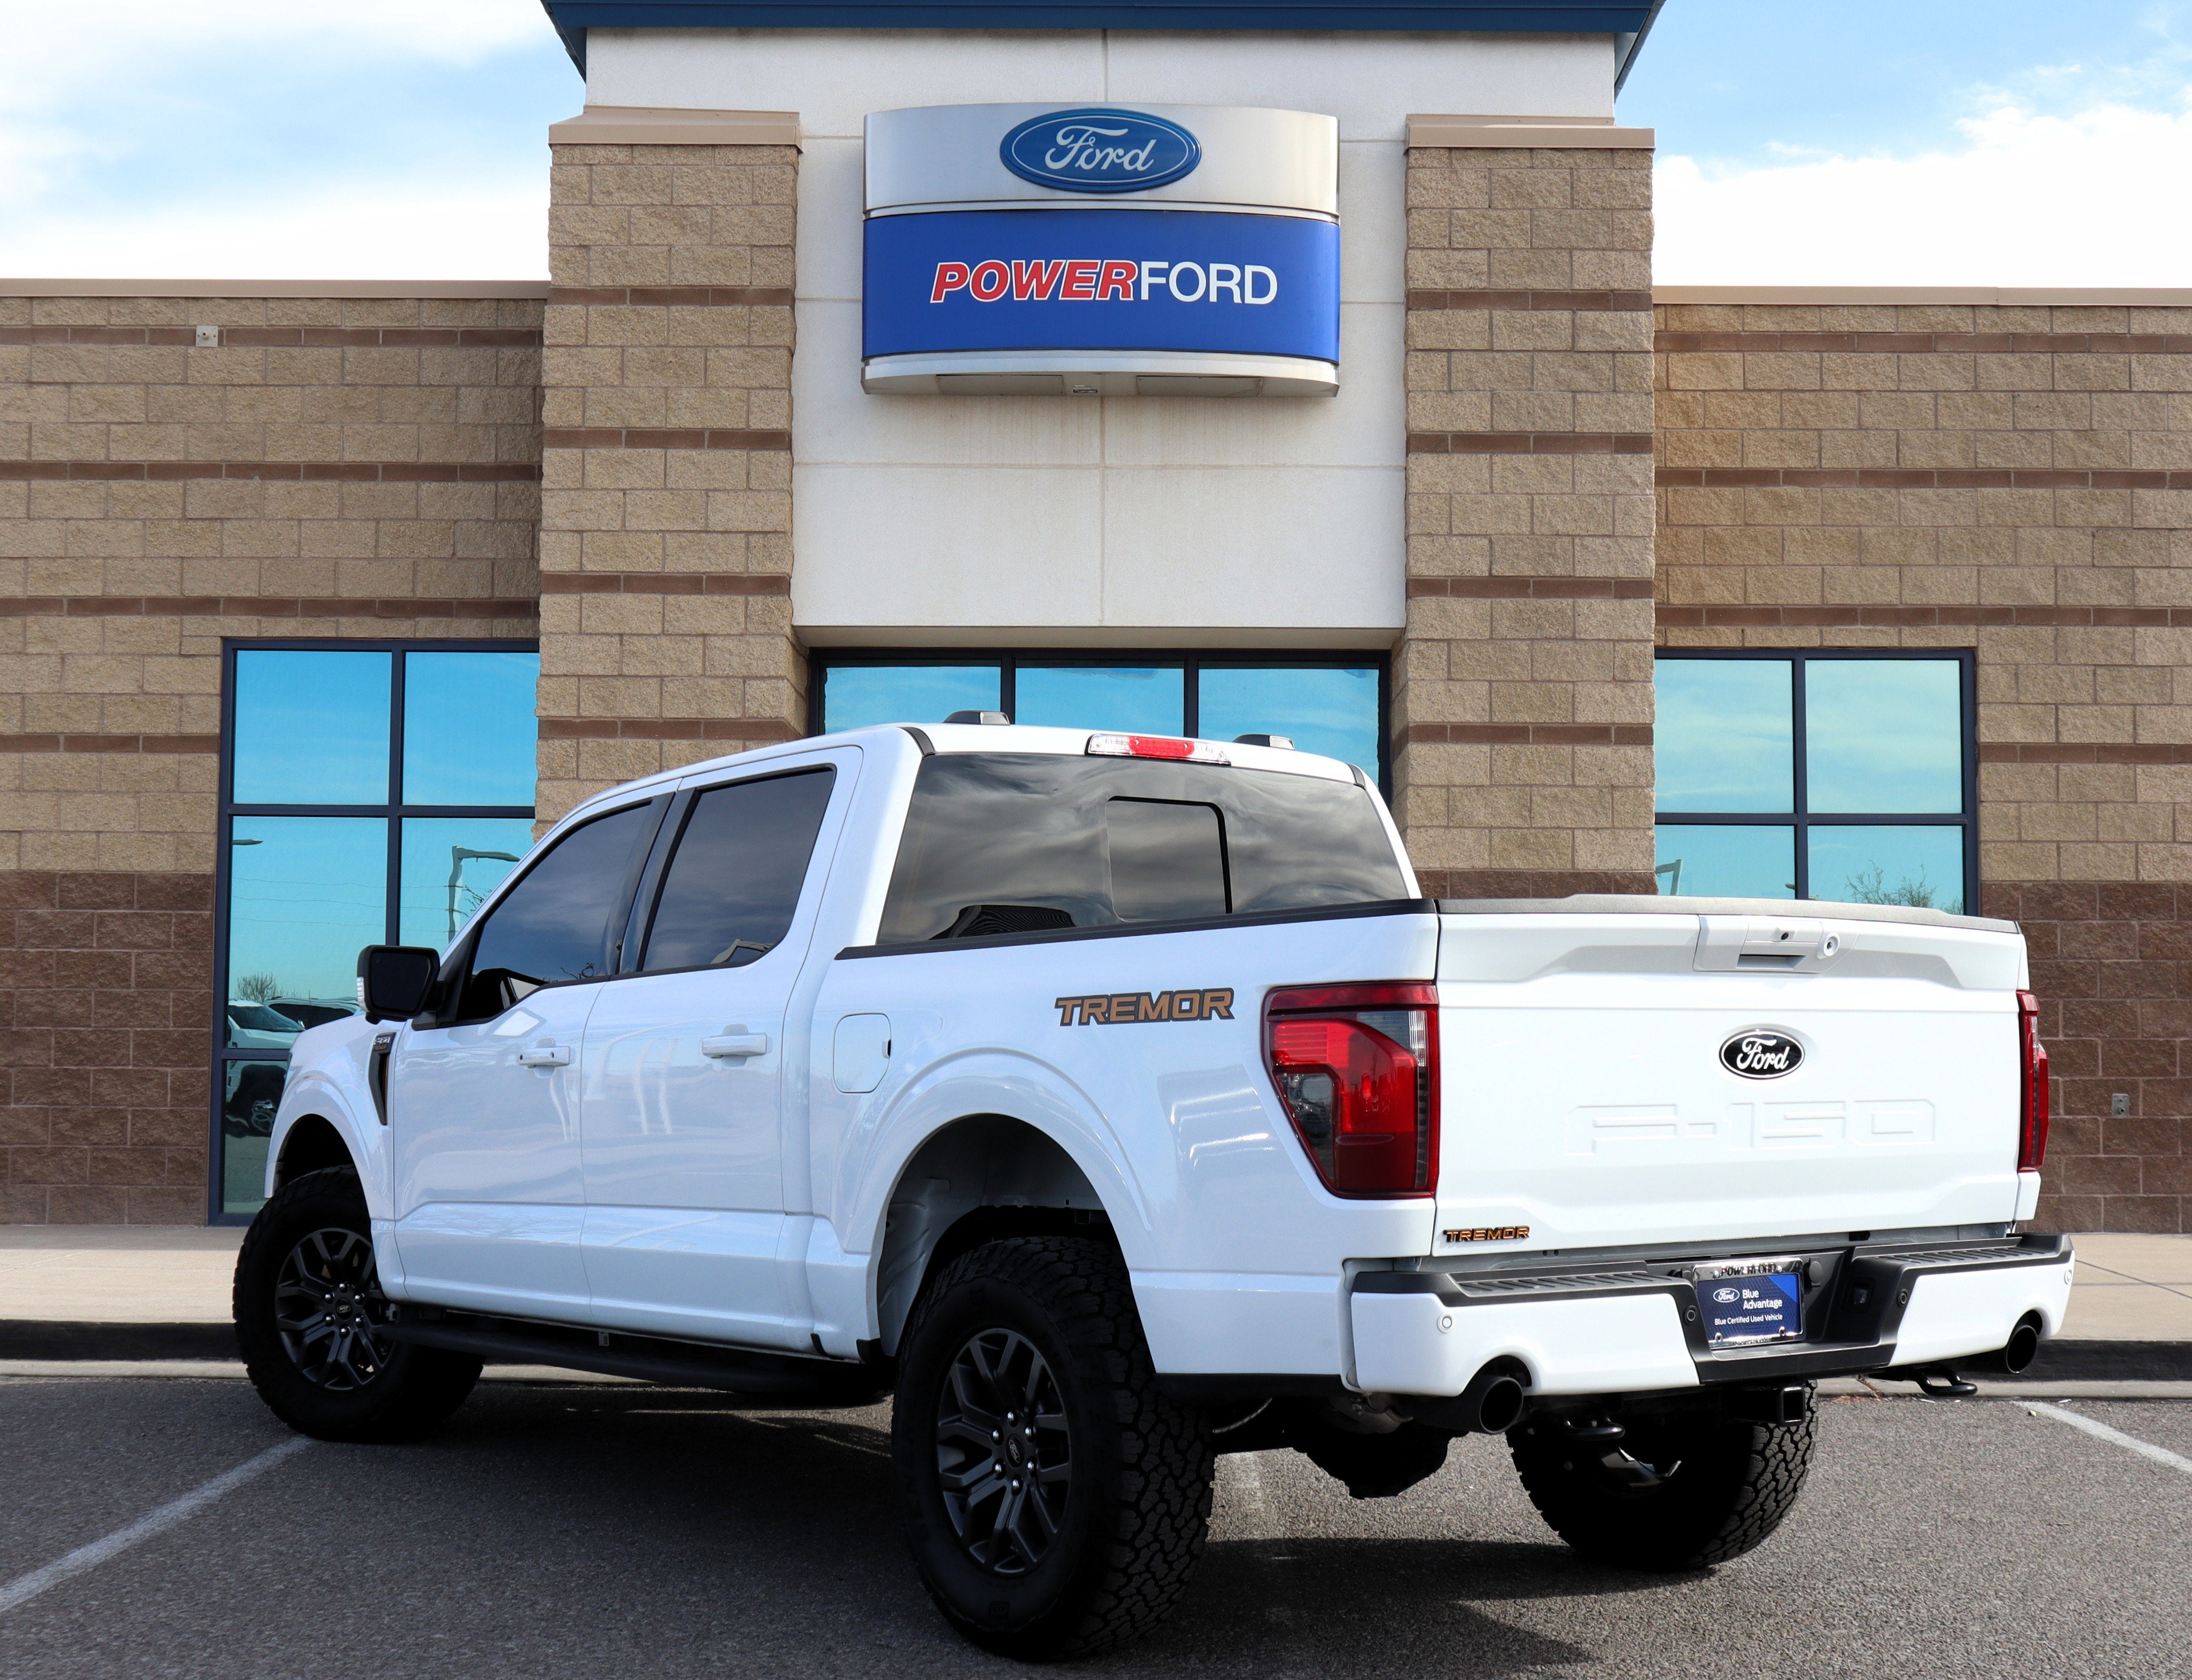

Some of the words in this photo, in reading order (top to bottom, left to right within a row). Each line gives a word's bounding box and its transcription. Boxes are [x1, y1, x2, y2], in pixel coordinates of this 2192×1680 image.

[1045, 126, 1157, 171] Ford
[1054, 988, 1235, 1026] TREMOR
[1736, 1037, 1790, 1070] Ford
[1564, 1099, 1936, 1156] F-150
[1444, 1226, 1529, 1242] TREMOR
[1718, 1290, 1735, 1301] Ford
[1742, 1289, 1759, 1299] Blue
[1743, 1299, 1782, 1310] Advantage
[1715, 1317, 1726, 1325] Blue
[1727, 1316, 1750, 1324] Certified
